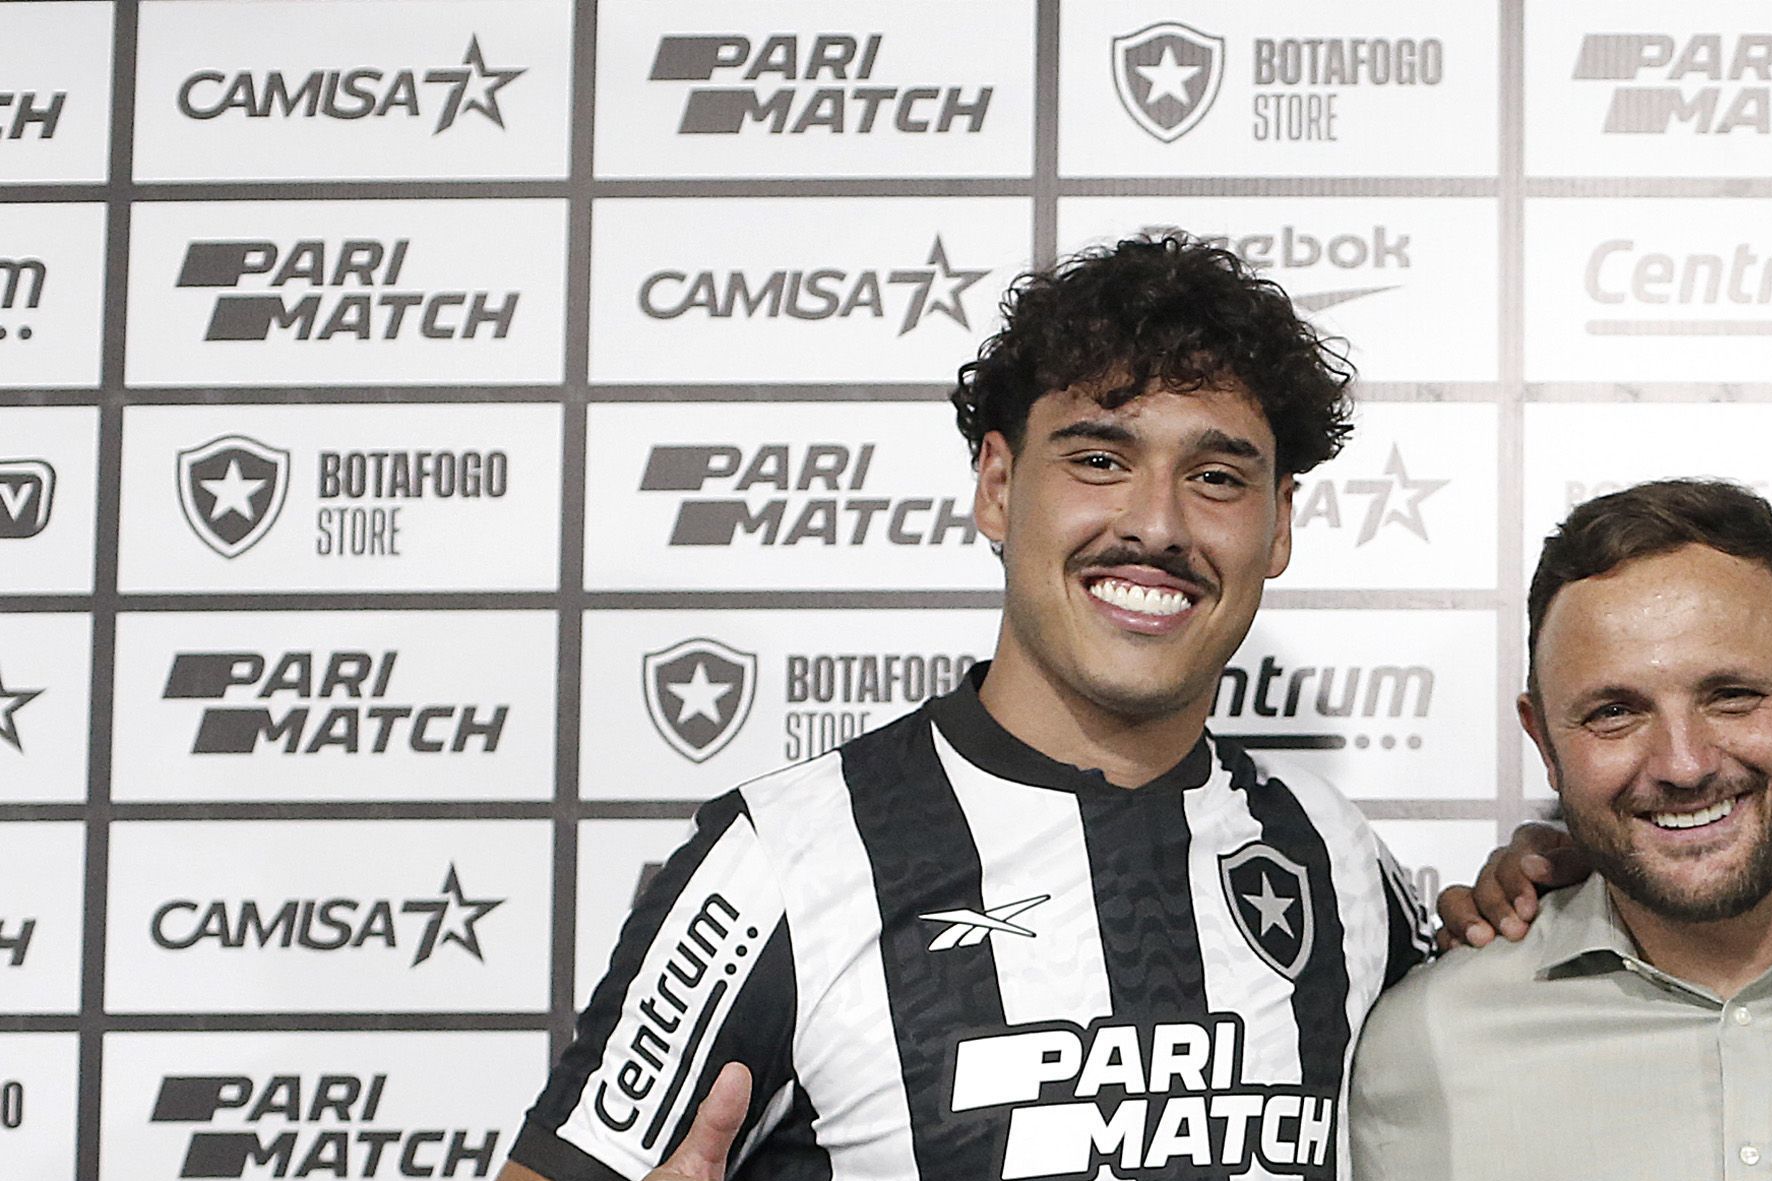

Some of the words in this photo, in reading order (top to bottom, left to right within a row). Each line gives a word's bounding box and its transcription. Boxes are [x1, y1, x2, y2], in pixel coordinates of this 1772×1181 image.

[695, 33, 883, 81] PARI
[1253, 37, 1443, 87] BOTAFOGO
[725, 86, 994, 135] MATCH
[1253, 93, 1338, 142] STORE
[222, 239, 410, 287] PARI
[1142, 225, 1411, 269] ebok
[255, 292, 520, 341] MATCH
[318, 450, 507, 499] BOTAFOGO
[684, 443, 876, 492] PARI
[316, 507, 401, 557] STORE
[719, 498, 977, 545] MATCH
[212, 650, 398, 699] PARI
[1210, 655, 1434, 718] ntrum
[242, 705, 510, 755] MATCH
[594, 890, 741, 1135] Centrum
[1018, 1021, 1237, 1099] PARI
[198, 1073, 387, 1123] PARI
[231, 1129, 500, 1179] MATCH
[1070, 1095, 1332, 1171] MATCH
